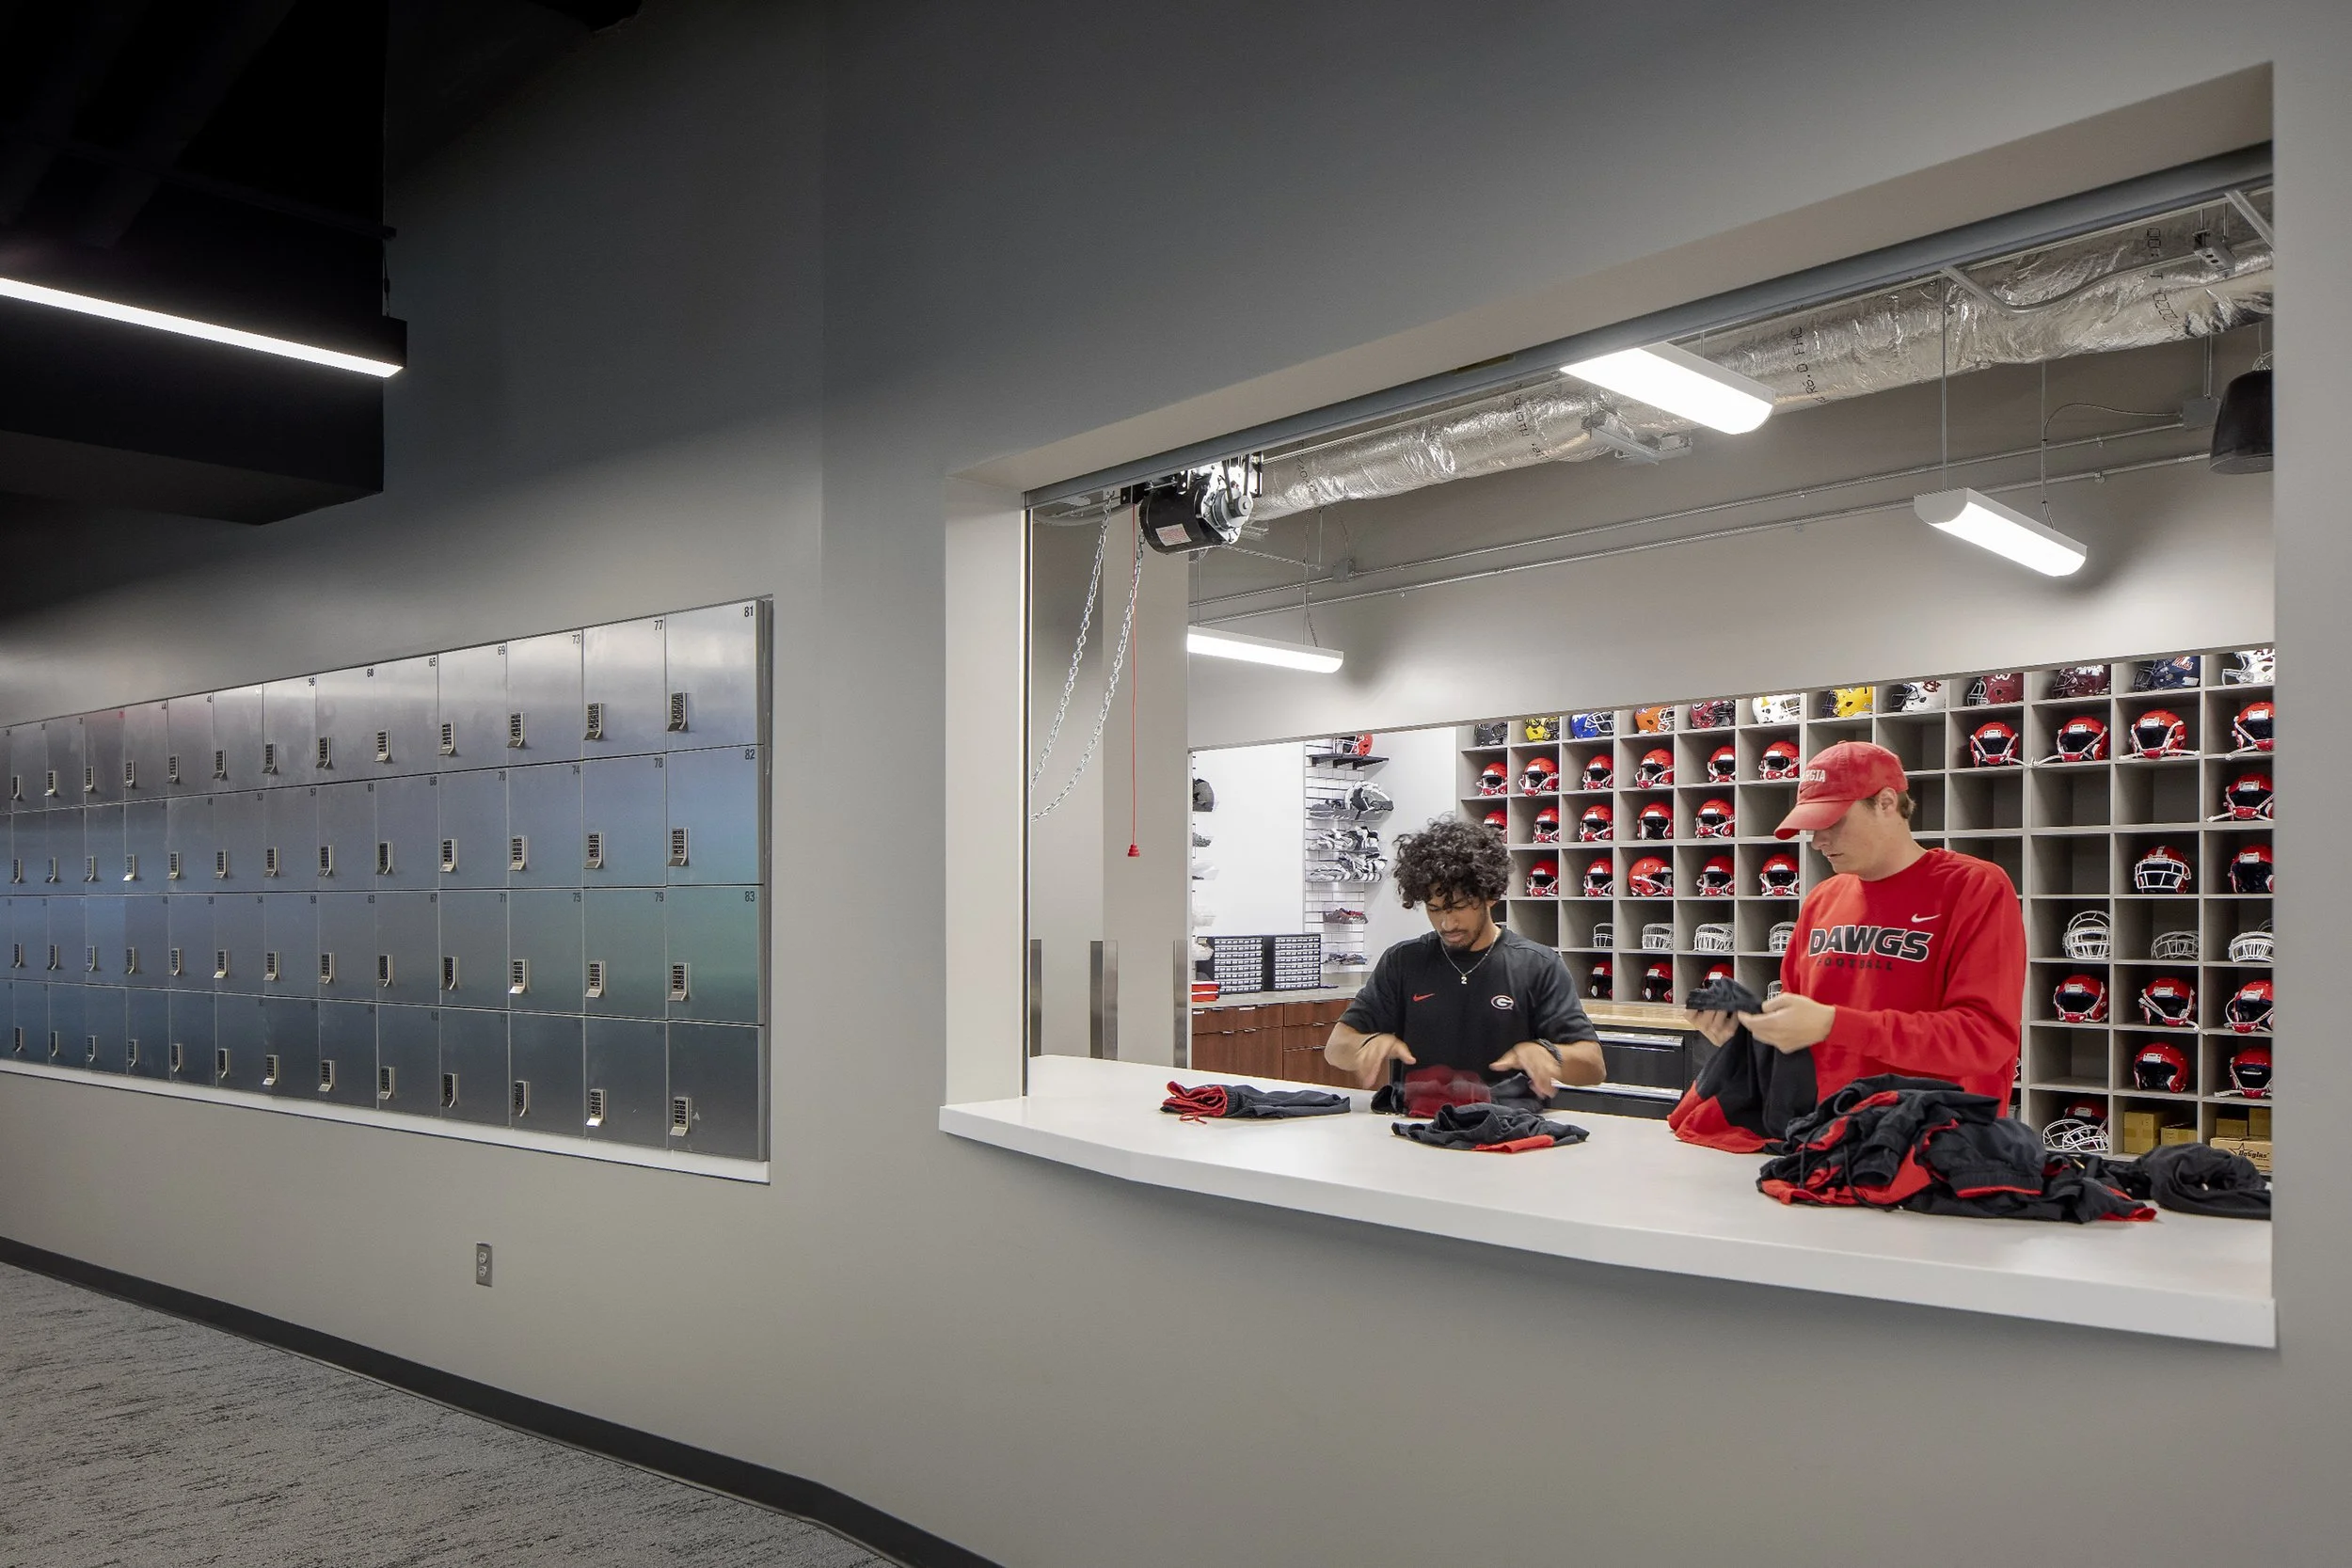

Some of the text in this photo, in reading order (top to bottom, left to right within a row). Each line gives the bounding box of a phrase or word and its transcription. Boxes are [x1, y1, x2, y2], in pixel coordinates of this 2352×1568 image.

[1790, 325, 1805, 356] FHC
[743, 606, 754, 617] 81
[654, 619, 663, 630] 77
[572, 634, 580, 644] 73
[497, 645, 505, 656] 69
[428, 657, 437, 667] 65
[366, 668, 374, 677] 60
[308, 677, 315, 687] 56
[744, 749, 755, 760] 82
[654, 757, 663, 768] 78
[572, 765, 580, 775] 74
[429, 776, 437, 786] 66
[498, 771, 506, 782] 70
[310, 787, 316, 797] 57
[367, 783, 373, 792] 61
[430, 894, 437, 903] 67
[500, 894, 506, 902] 71
[572, 893, 581, 902] 75
[655, 892, 664, 902] 79
[744, 891, 755, 902] 83
[1808, 925, 1934, 962] DAWGS
[1817, 958, 1893, 971] FOOTBALL
[1460, 976, 1468, 985] 2
[1490, 994, 1515, 1010] G
[2238, 1150, 2267, 1159] Douglas
